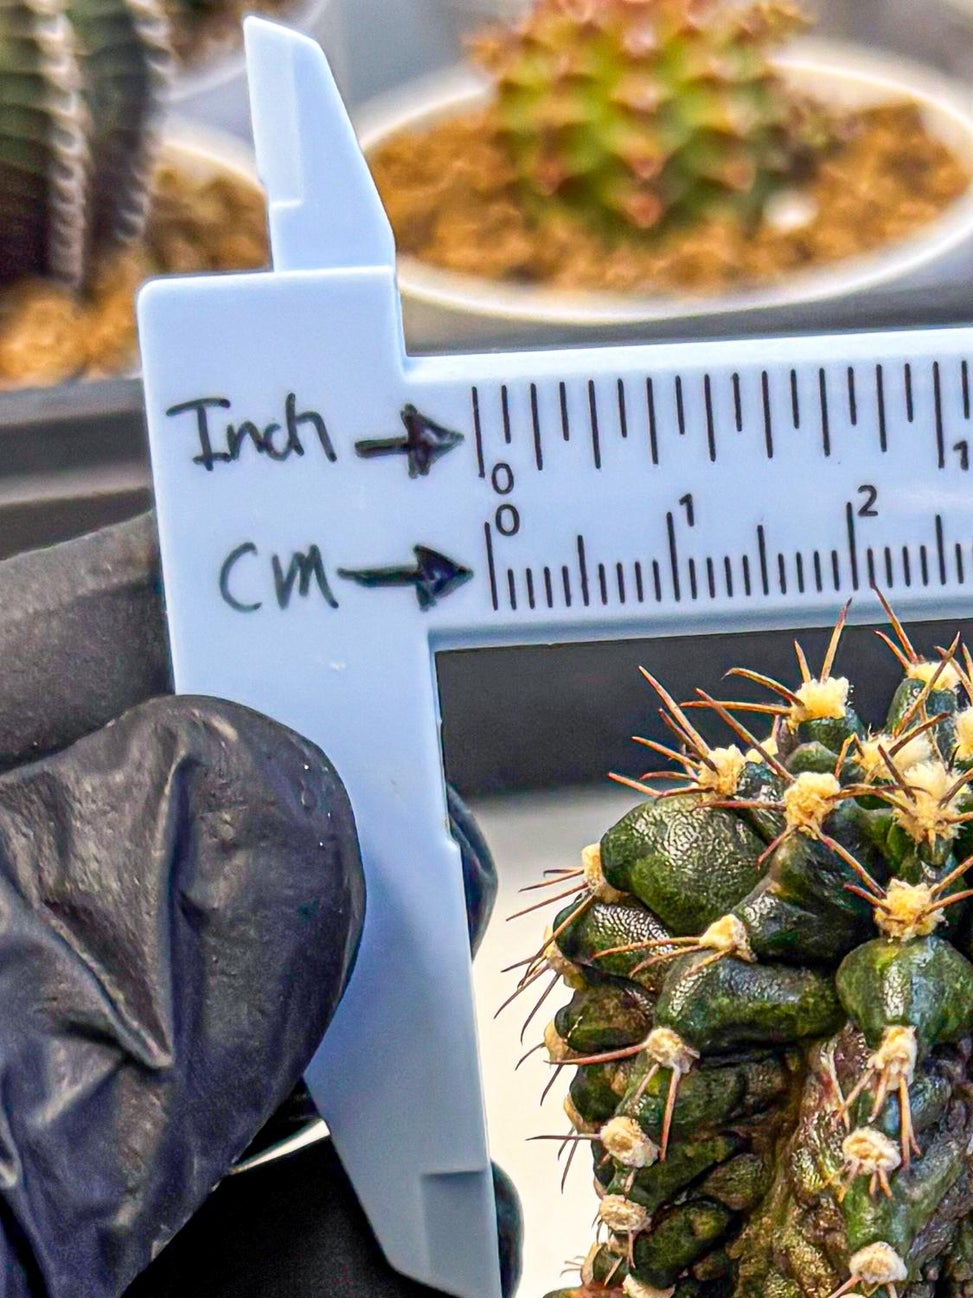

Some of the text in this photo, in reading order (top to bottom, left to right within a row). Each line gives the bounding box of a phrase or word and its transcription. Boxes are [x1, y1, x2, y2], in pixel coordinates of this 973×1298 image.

[165, 391, 338, 472] Inch
[491, 462, 515, 496] 0
[952, 440, 970, 472] 1
[494, 502, 521, 537] 0
[679, 492, 695, 527] 1
[856, 483, 880, 518] 2
